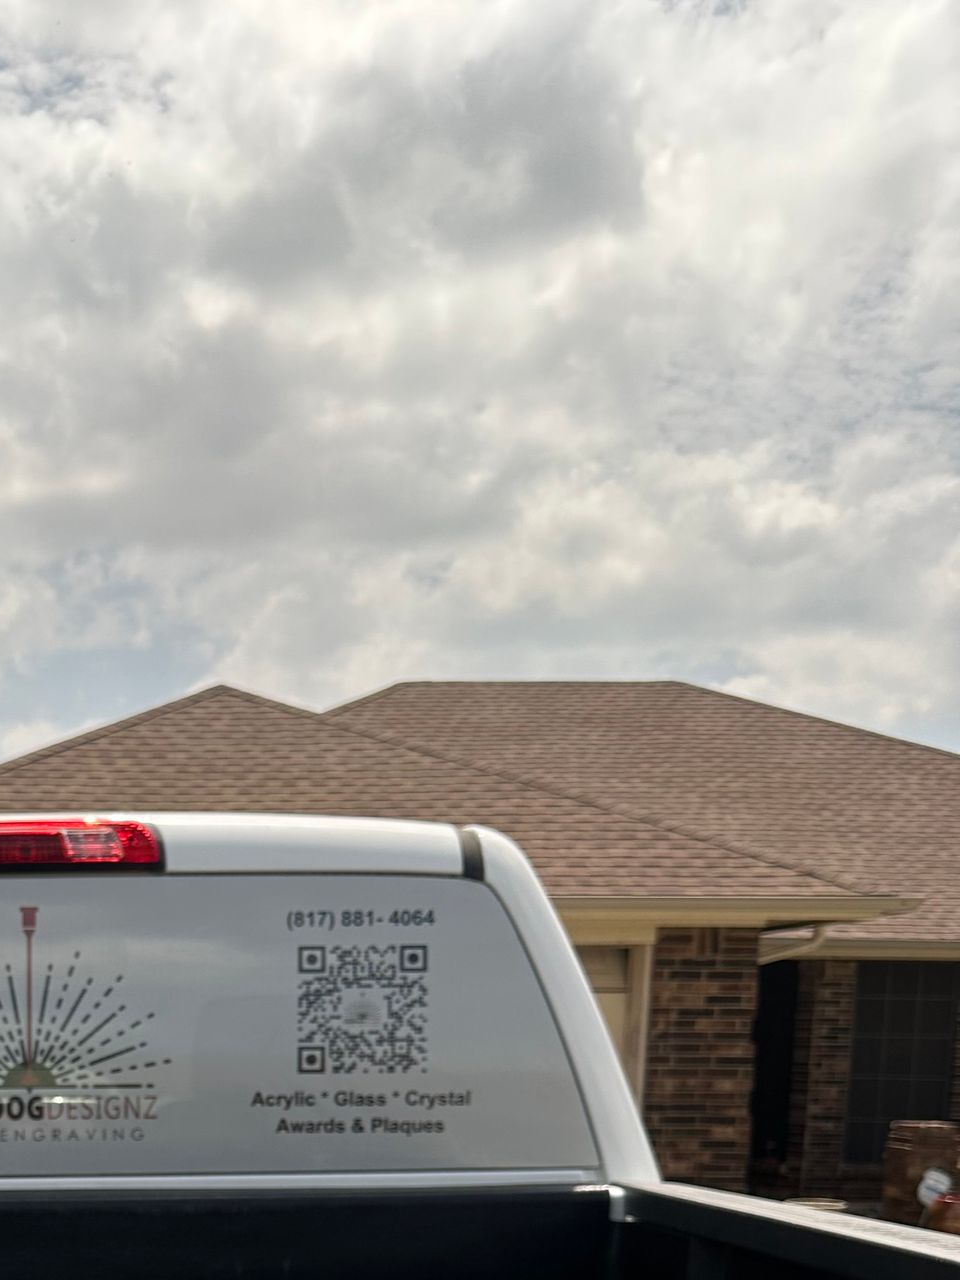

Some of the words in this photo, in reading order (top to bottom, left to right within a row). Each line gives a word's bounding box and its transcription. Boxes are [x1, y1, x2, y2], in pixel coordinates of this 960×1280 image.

[286, 911, 335, 930] (817)
[388, 910, 435, 926] 4064
[251, 1091, 317, 1110] Acrylic
[334, 1091, 387, 1107] Glass
[404, 1090, 472, 1110] Crystal
[0, 1128, 146, 1142] ENGRAVING
[275, 1119, 346, 1134] Awards
[351, 1119, 365, 1134] &
[370, 1118, 445, 1136] Plaques
